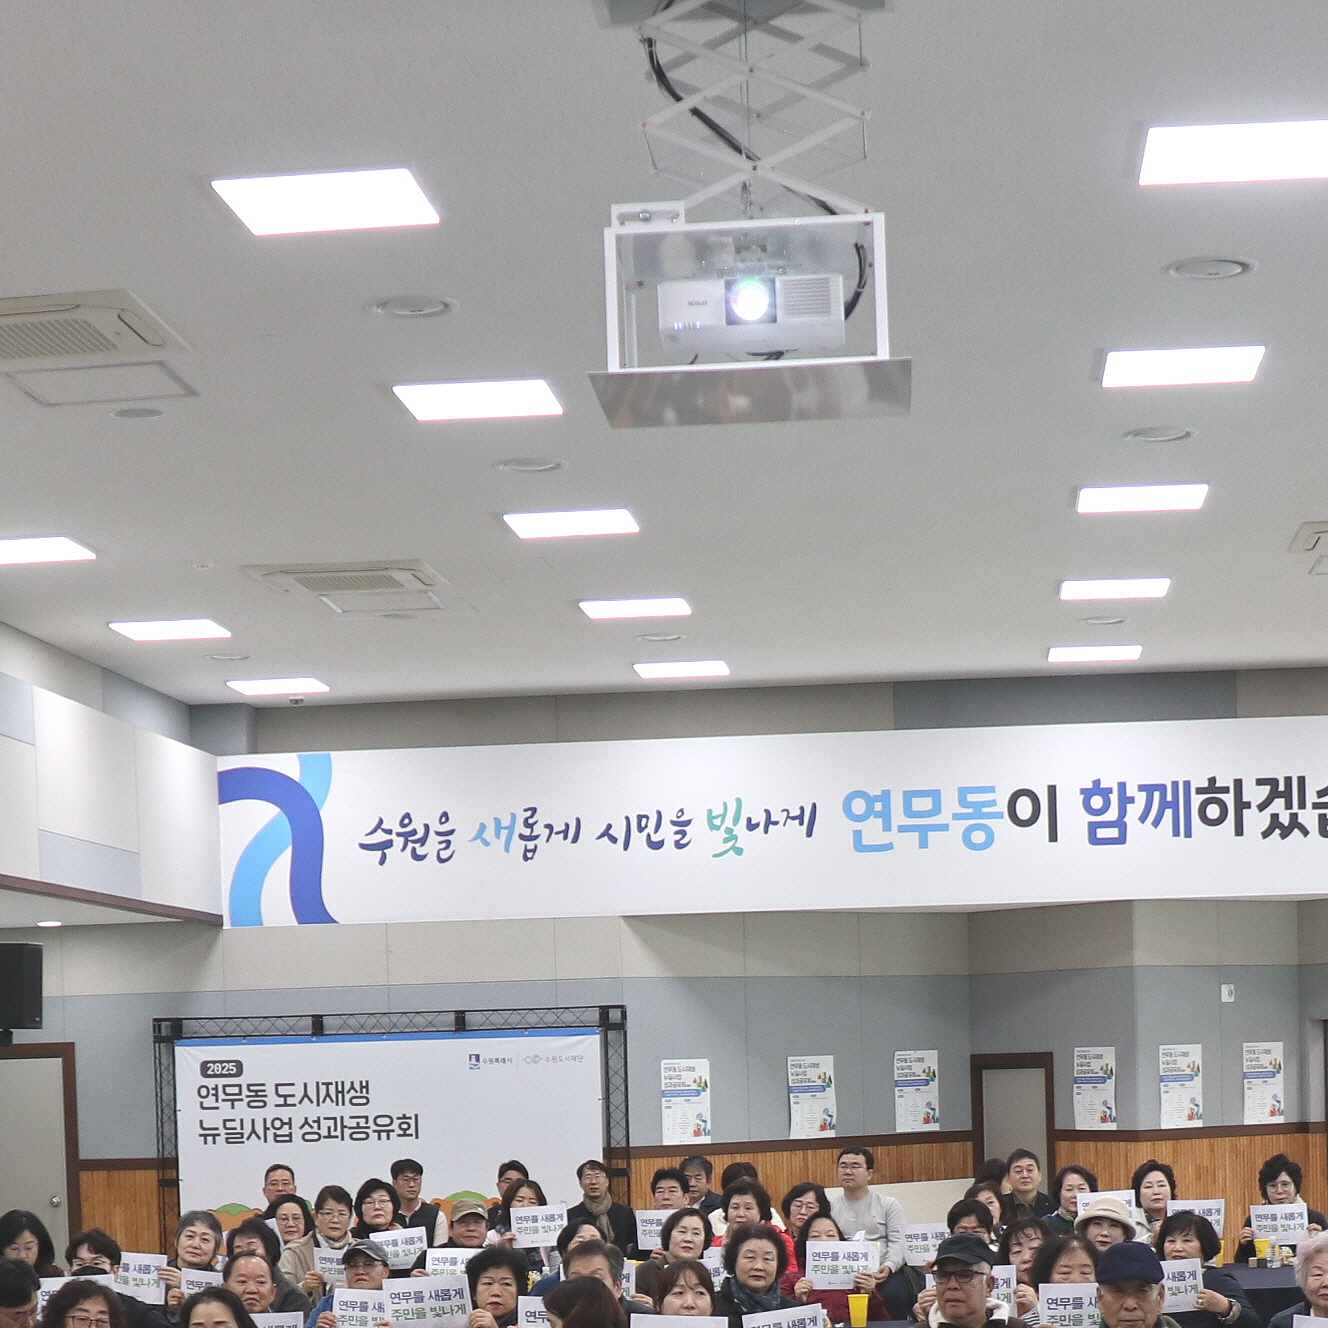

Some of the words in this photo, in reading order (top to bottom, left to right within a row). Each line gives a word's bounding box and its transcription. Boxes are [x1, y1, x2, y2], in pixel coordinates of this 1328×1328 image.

[358, 810, 456, 866] 수원을
[468, 806, 581, 862] 새롭게
[595, 808, 693, 851] 시민을
[706, 797, 817, 858] 빛나게
[842, 784, 1058, 856] 연무동이
[206, 1062, 237, 1075] 2025
[196, 1081, 268, 1110] 연무동
[274, 1079, 370, 1109] 도시재생
[197, 1116, 294, 1145] 뉴딜사업
[299, 1112, 419, 1143] 성과공유회
[515, 1214, 538, 1225] 연무를
[541, 1213, 564, 1223] 새롭게
[1255, 1213, 1278, 1222] 연무를
[1280, 1211, 1304, 1221] 새롭게
[516, 1226, 539, 1235] 주민을
[541, 1224, 563, 1234] 빛나게
[1256, 1223, 1279, 1233] 주민을
[1280, 1222, 1304, 1232] 빛나게
[811, 1251, 840, 1262] 연무를
[843, 1251, 869, 1262] 새롭게
[811, 1264, 840, 1275] 주민을
[1166, 1270, 1198, 1282] 새롭게
[390, 1290, 425, 1305] 연무를
[428, 1286, 465, 1301] 새롭게
[1167, 1283, 1198, 1296] 빛나게
[338, 1299, 369, 1312] 연무를
[1046, 1296, 1084, 1310] 연무를
[391, 1307, 426, 1320] 주민을
[429, 1303, 467, 1317] 빛나게
[337, 1313, 368, 1326] 주민을
[785, 1315, 818, 1328] 새롭게
[1046, 1313, 1084, 1326] 주민을
